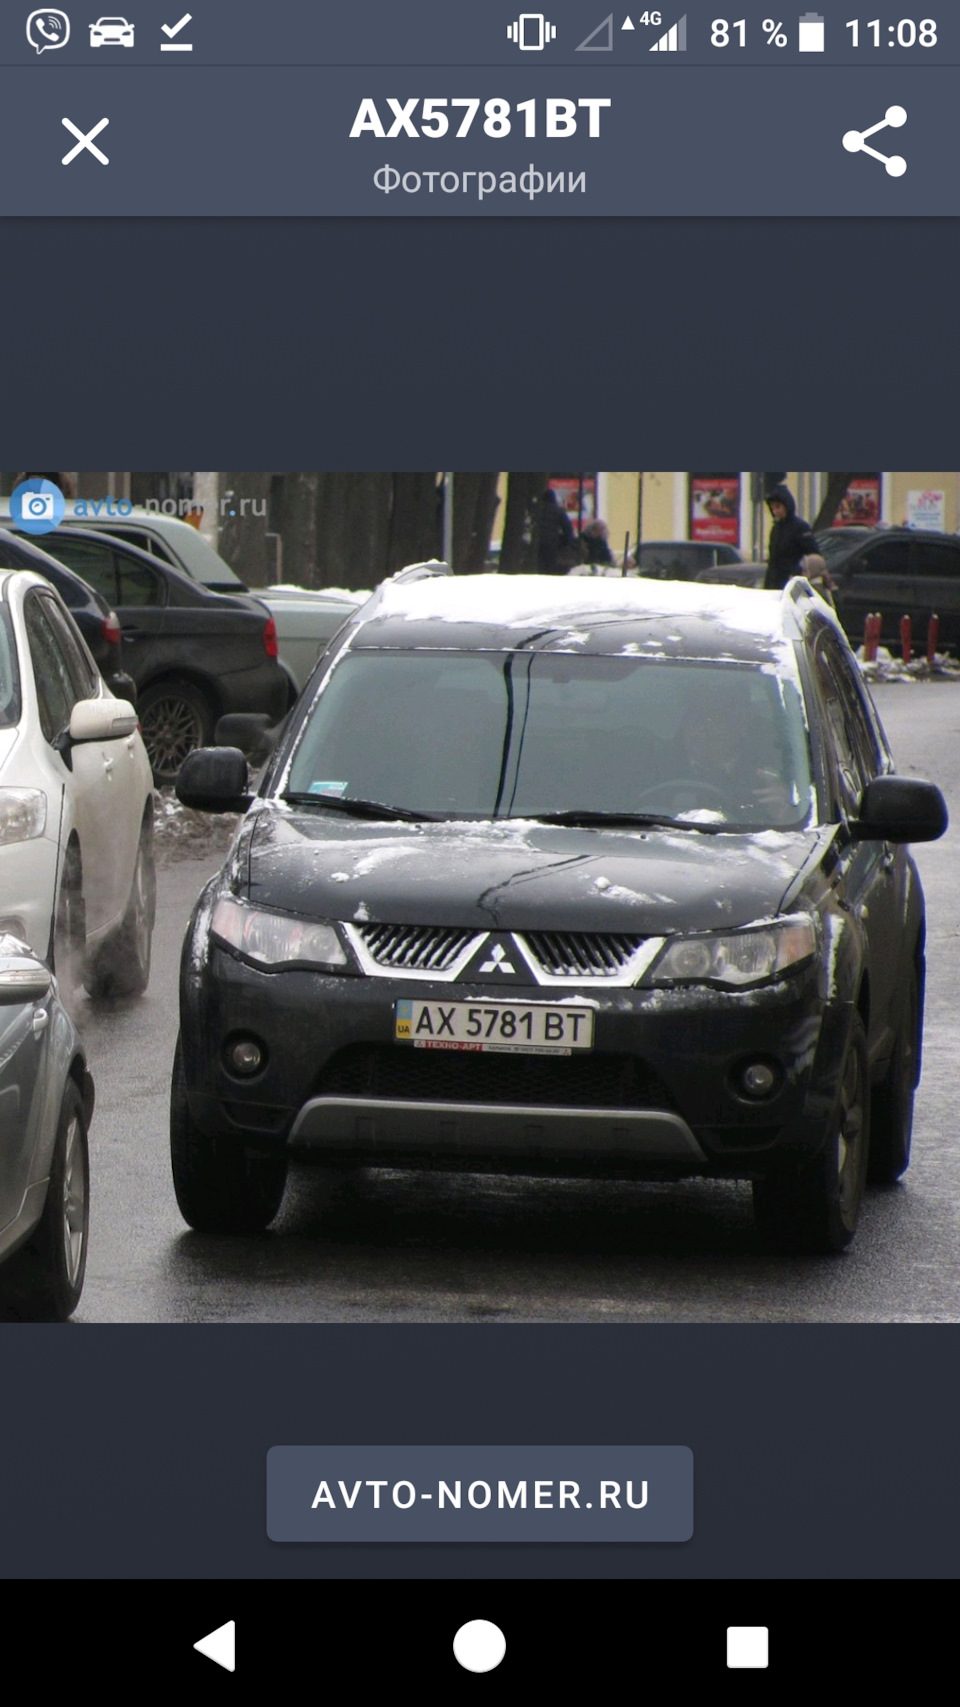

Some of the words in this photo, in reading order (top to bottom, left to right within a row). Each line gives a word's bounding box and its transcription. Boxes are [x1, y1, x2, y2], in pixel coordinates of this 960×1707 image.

[640, 11, 661, 25] 4G
[711, 19, 745, 47] 81
[846, 19, 938, 47] 11:08
[349, 98, 611, 138] AX5781BT
[373, 164, 586, 201] Фотографии
[397, 1025, 411, 1034] UA
[415, 1006, 456, 1036] AX
[466, 1009, 532, 1040] 5781
[544, 1012, 586, 1042] BT
[427, 1041, 482, 1051] ТЕХНО-АРТ
[311, 1481, 648, 1509] AVTO-NOMER.RU
